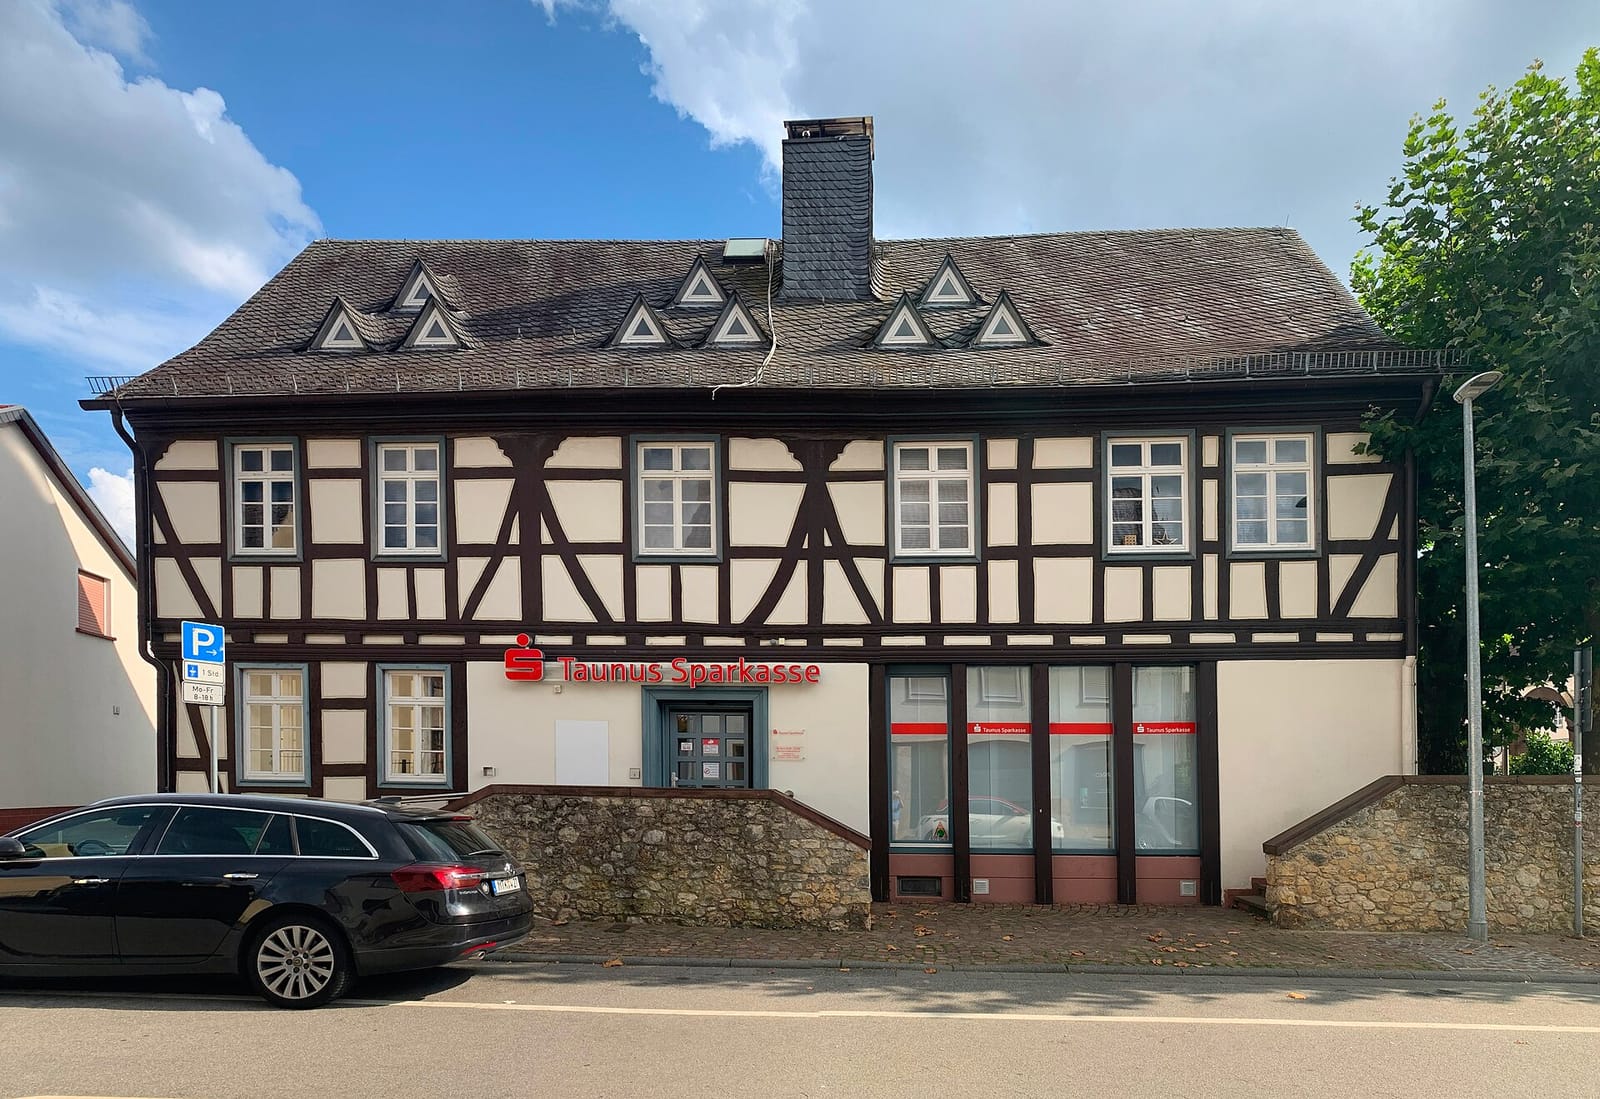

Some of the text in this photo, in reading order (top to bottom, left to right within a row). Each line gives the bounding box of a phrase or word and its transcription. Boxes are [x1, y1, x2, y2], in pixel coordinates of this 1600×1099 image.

[192, 628, 214, 655] P
[557, 656, 663, 682] Taunus
[671, 657, 821, 688] Sparkasse
